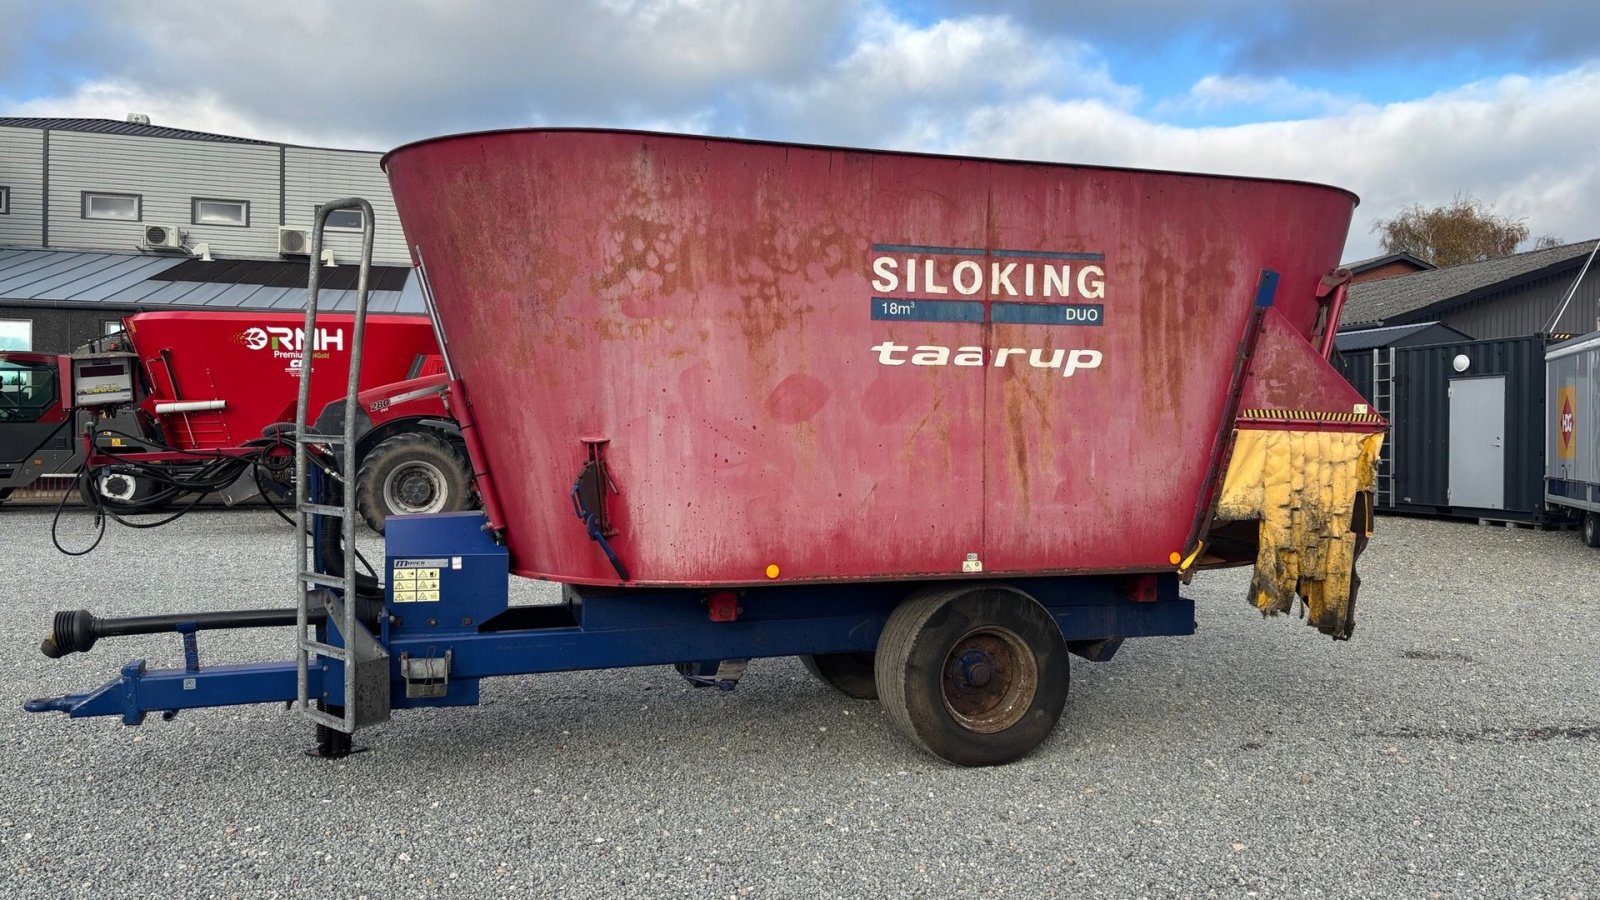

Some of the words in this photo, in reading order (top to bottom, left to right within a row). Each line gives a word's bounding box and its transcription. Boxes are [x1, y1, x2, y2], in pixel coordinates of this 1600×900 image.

[871, 257, 1105, 299] SILOKING
[1066, 308, 1098, 321] DUO
[274, 350, 303, 359] Premiu
[871, 341, 1103, 378] taarup
[371, 399, 390, 411] 280
